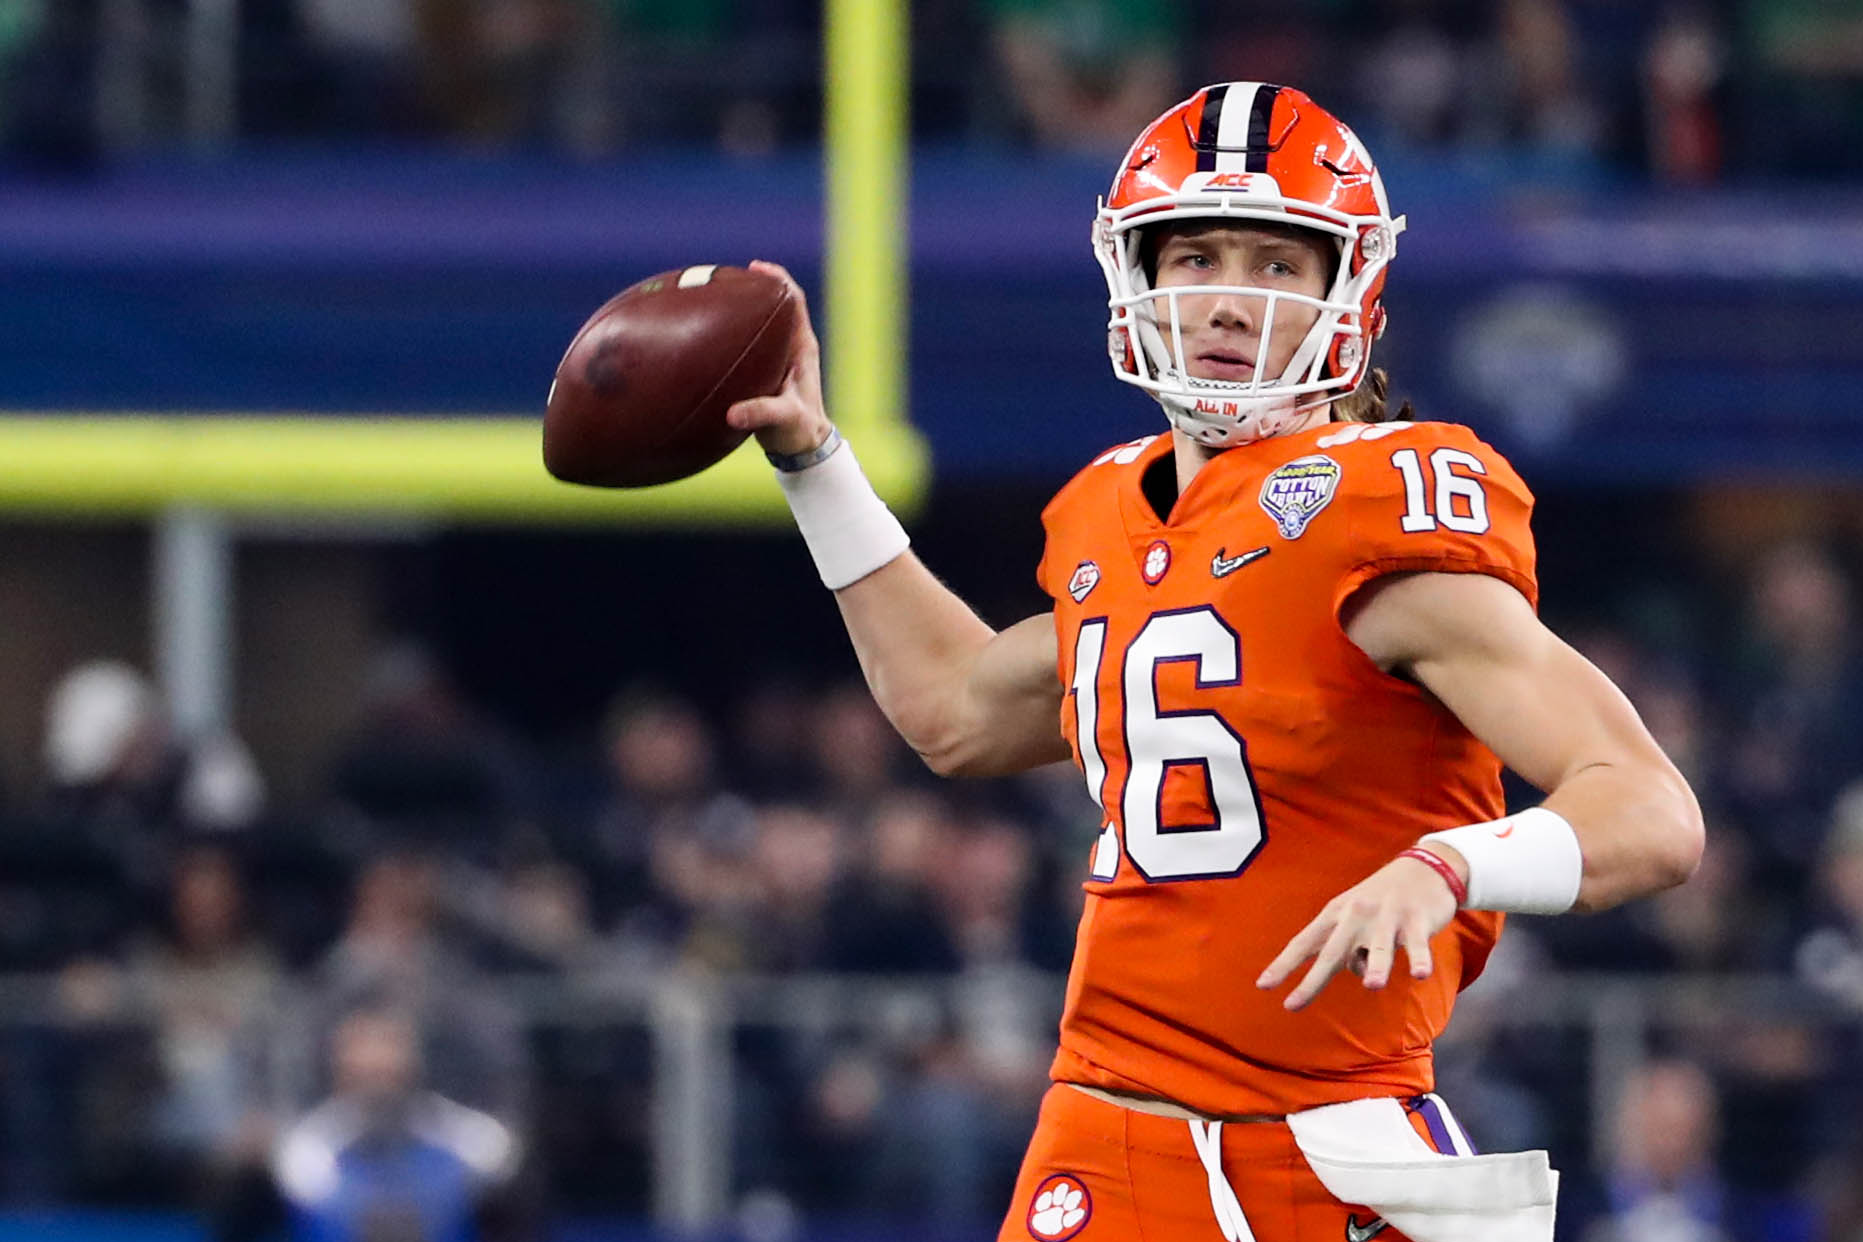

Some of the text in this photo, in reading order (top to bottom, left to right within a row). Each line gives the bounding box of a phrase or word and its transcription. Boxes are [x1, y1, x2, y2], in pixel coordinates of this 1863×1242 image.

[1206, 173, 1254, 187] ACC
[1194, 398, 1238, 417] ALL IN
[1266, 475, 1332, 501] COTTON
[1390, 447, 1490, 535] 16
[1071, 603, 1269, 884] 16
